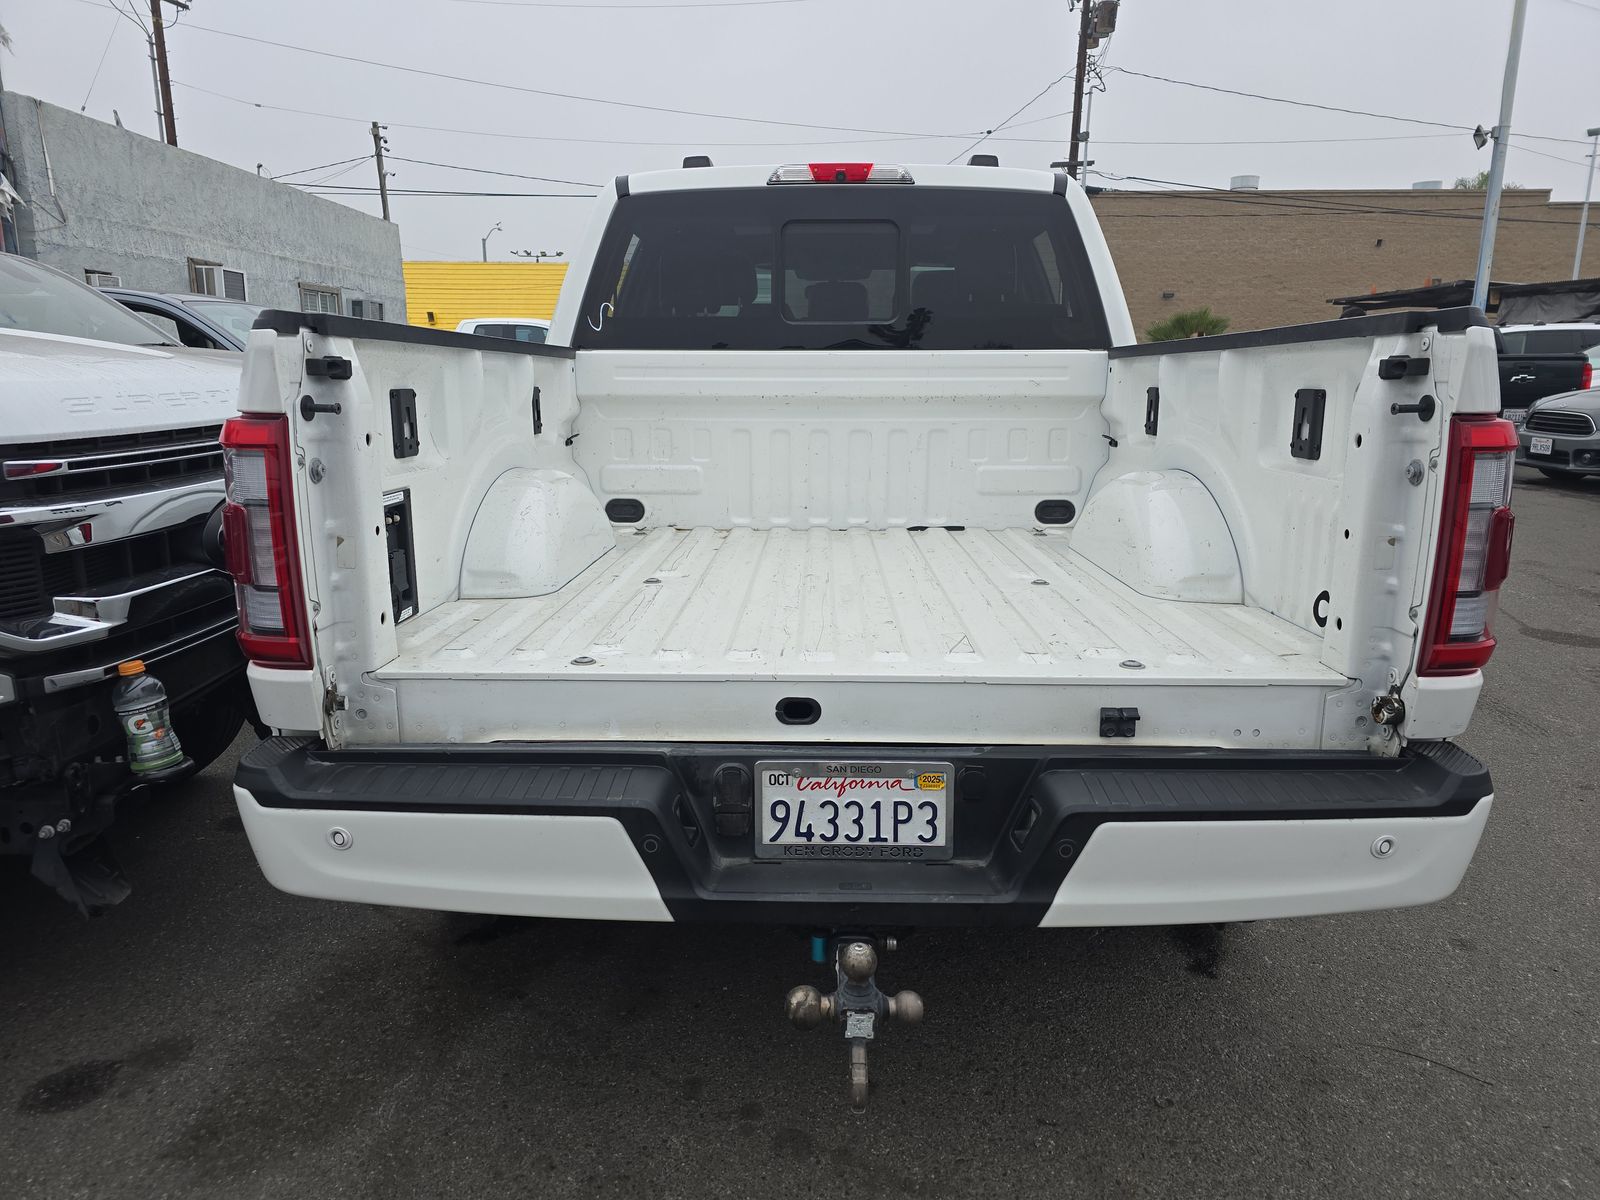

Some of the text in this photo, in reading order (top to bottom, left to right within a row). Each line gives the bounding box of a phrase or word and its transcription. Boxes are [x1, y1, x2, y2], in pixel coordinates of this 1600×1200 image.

[127, 713, 154, 735] G
[826, 765, 882, 774] SAN DIEGO
[768, 773, 791, 786] OCT
[922, 775, 941, 784] 2025
[796, 776, 915, 798] California
[769, 800, 938, 843] 94331P3
[784, 845, 815, 856] KEN
[880, 846, 924, 858] FORD
